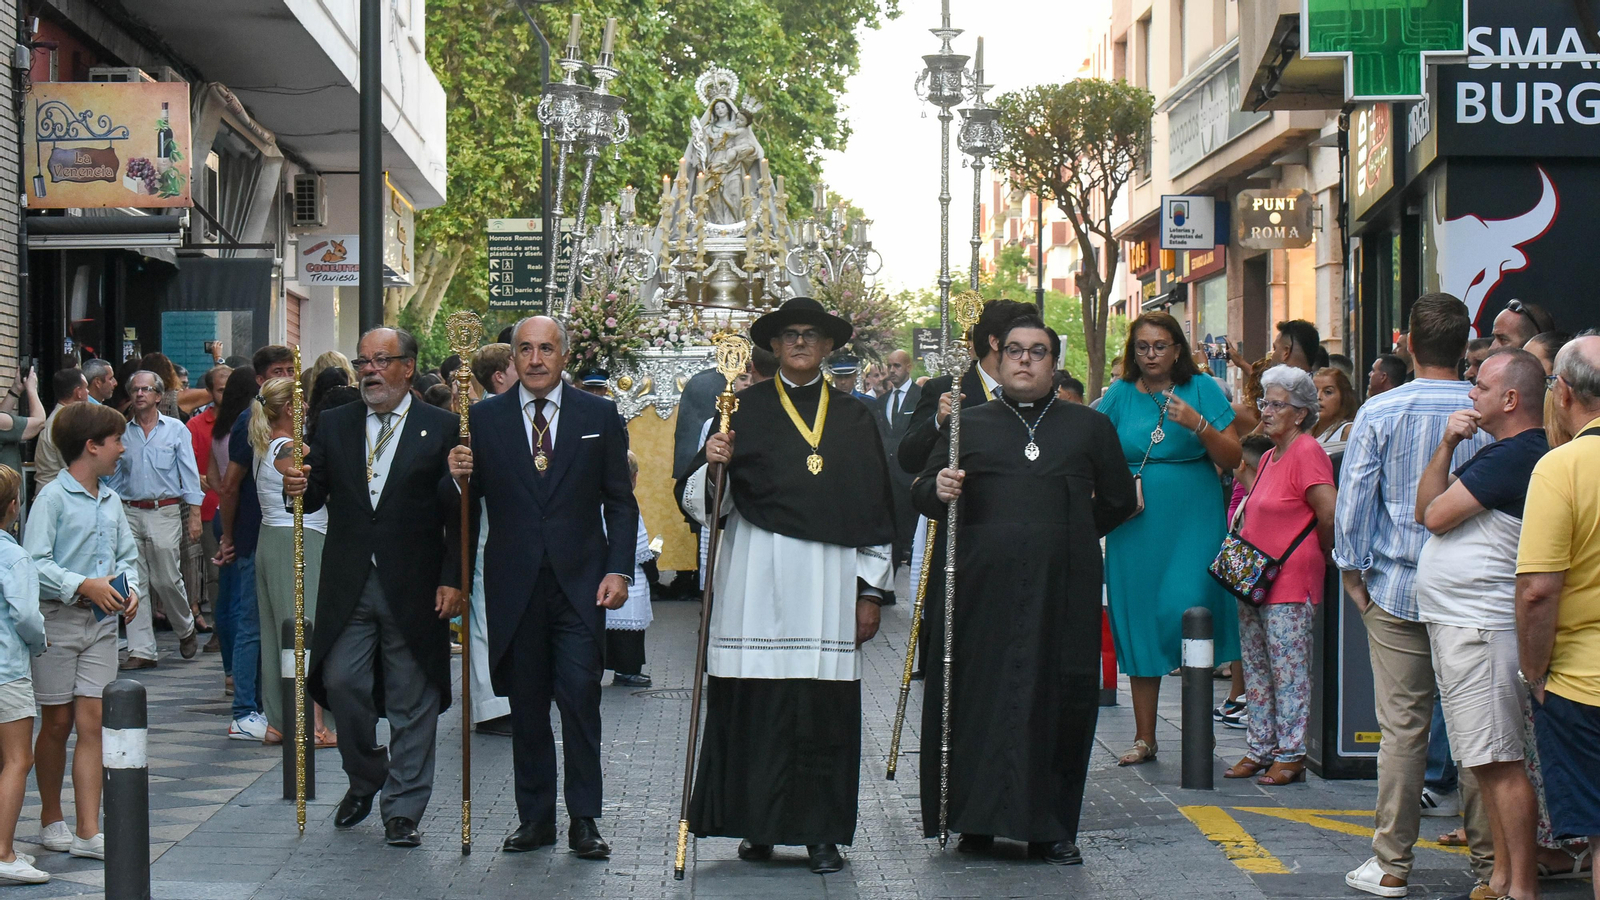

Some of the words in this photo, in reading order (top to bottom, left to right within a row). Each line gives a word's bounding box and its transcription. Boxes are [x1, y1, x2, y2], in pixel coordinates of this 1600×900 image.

[1468, 26, 1600, 69] SMA
[74, 152, 92, 164] La
[54, 164, 114, 179] Venencia
[1253, 198, 1297, 211] PUNT
[1251, 226, 1300, 239] ROMA
[310, 272, 358, 282] Traviesa
